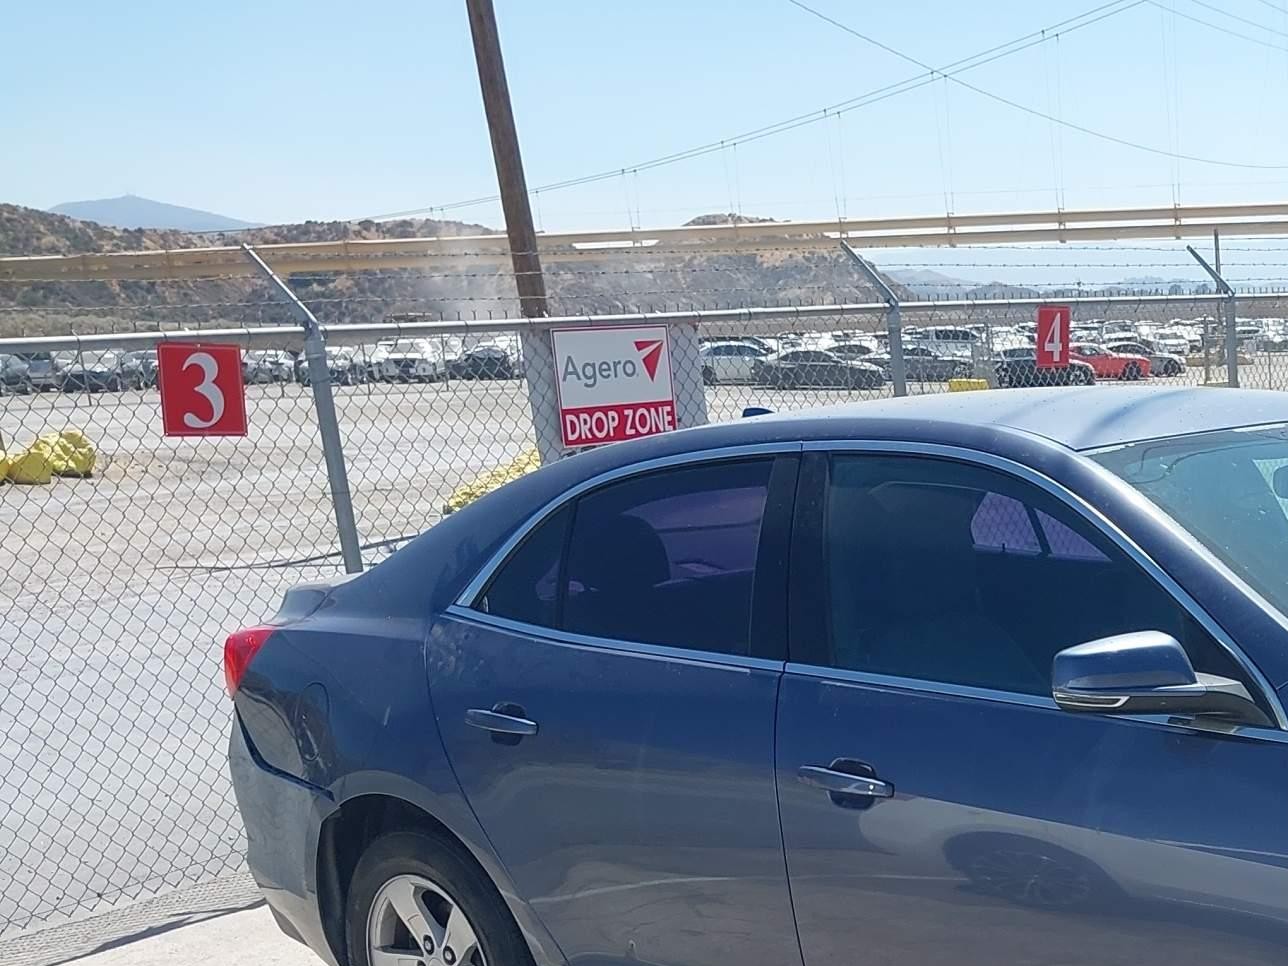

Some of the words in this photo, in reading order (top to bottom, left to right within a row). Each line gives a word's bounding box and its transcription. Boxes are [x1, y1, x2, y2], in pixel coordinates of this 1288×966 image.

[1044, 312, 1063, 362] 4
[181, 351, 225, 429] 3
[562, 355, 637, 389] Agero
[565, 410, 619, 441] DROP
[623, 405, 674, 435] ZONE
